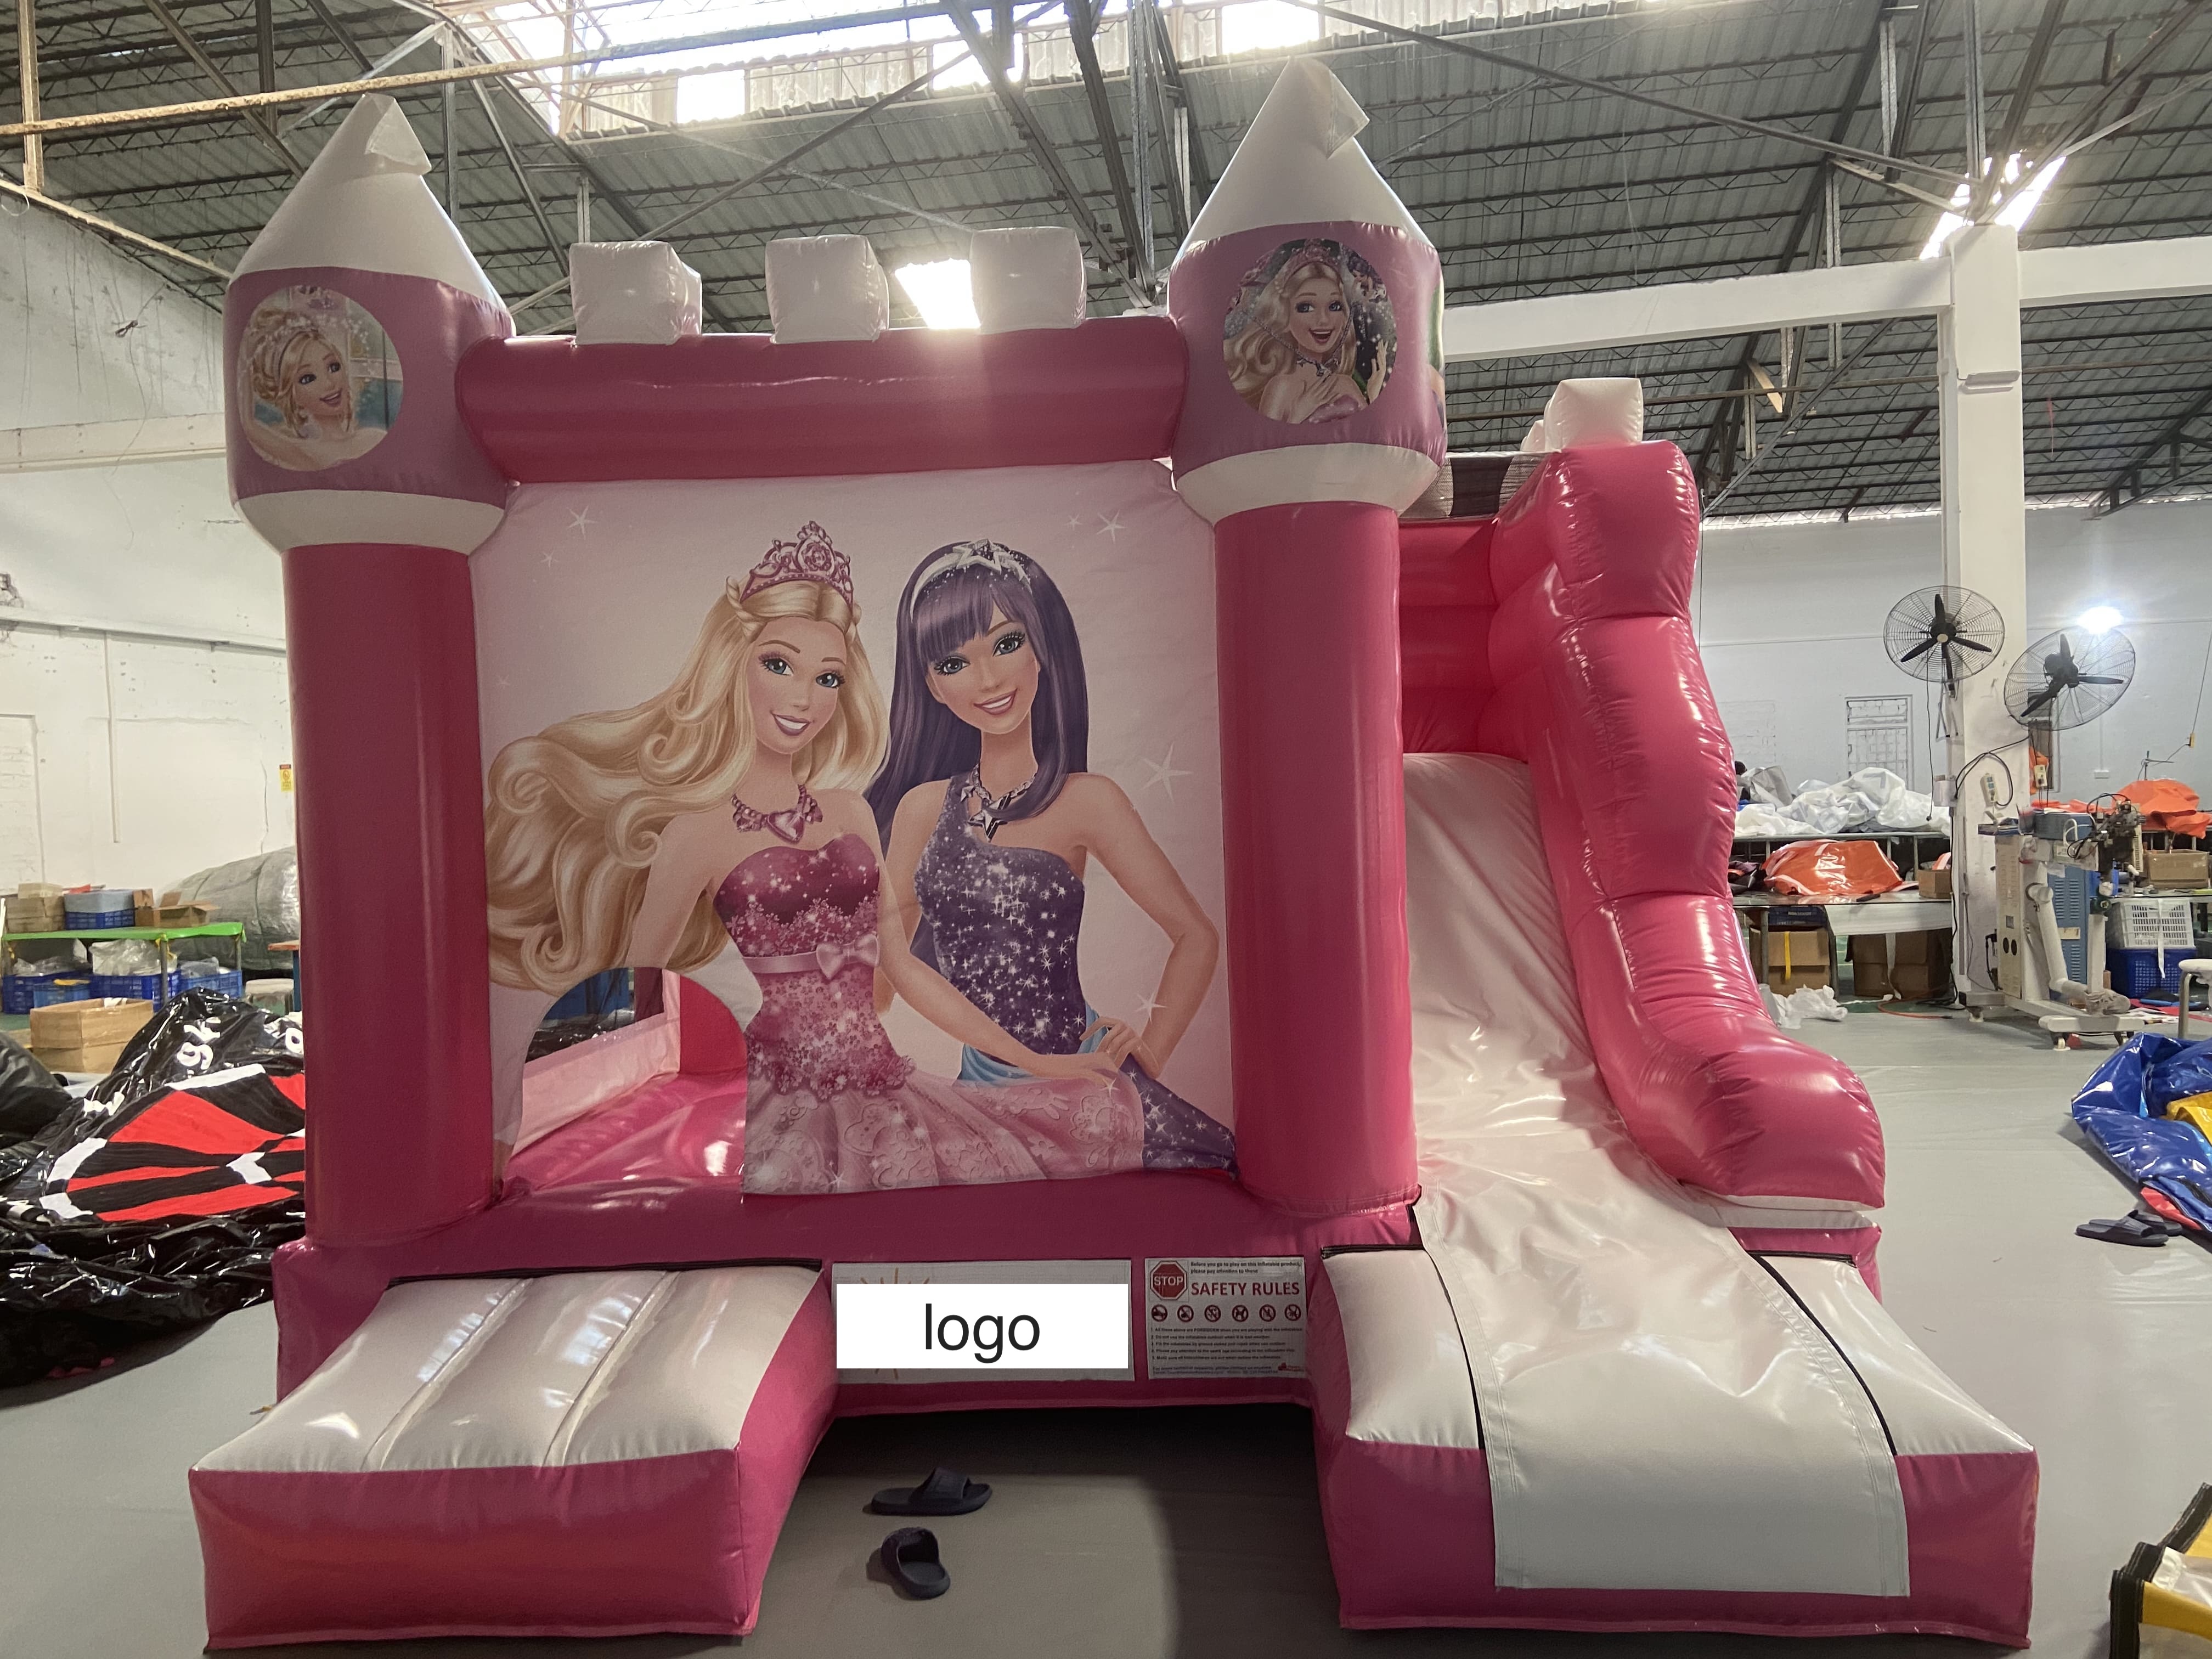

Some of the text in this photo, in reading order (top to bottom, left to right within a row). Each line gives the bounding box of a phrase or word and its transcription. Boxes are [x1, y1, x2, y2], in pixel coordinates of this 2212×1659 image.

[1154, 1277, 1183, 1286] STOP
[1191, 1282, 1300, 1295] SAFETY RULES
